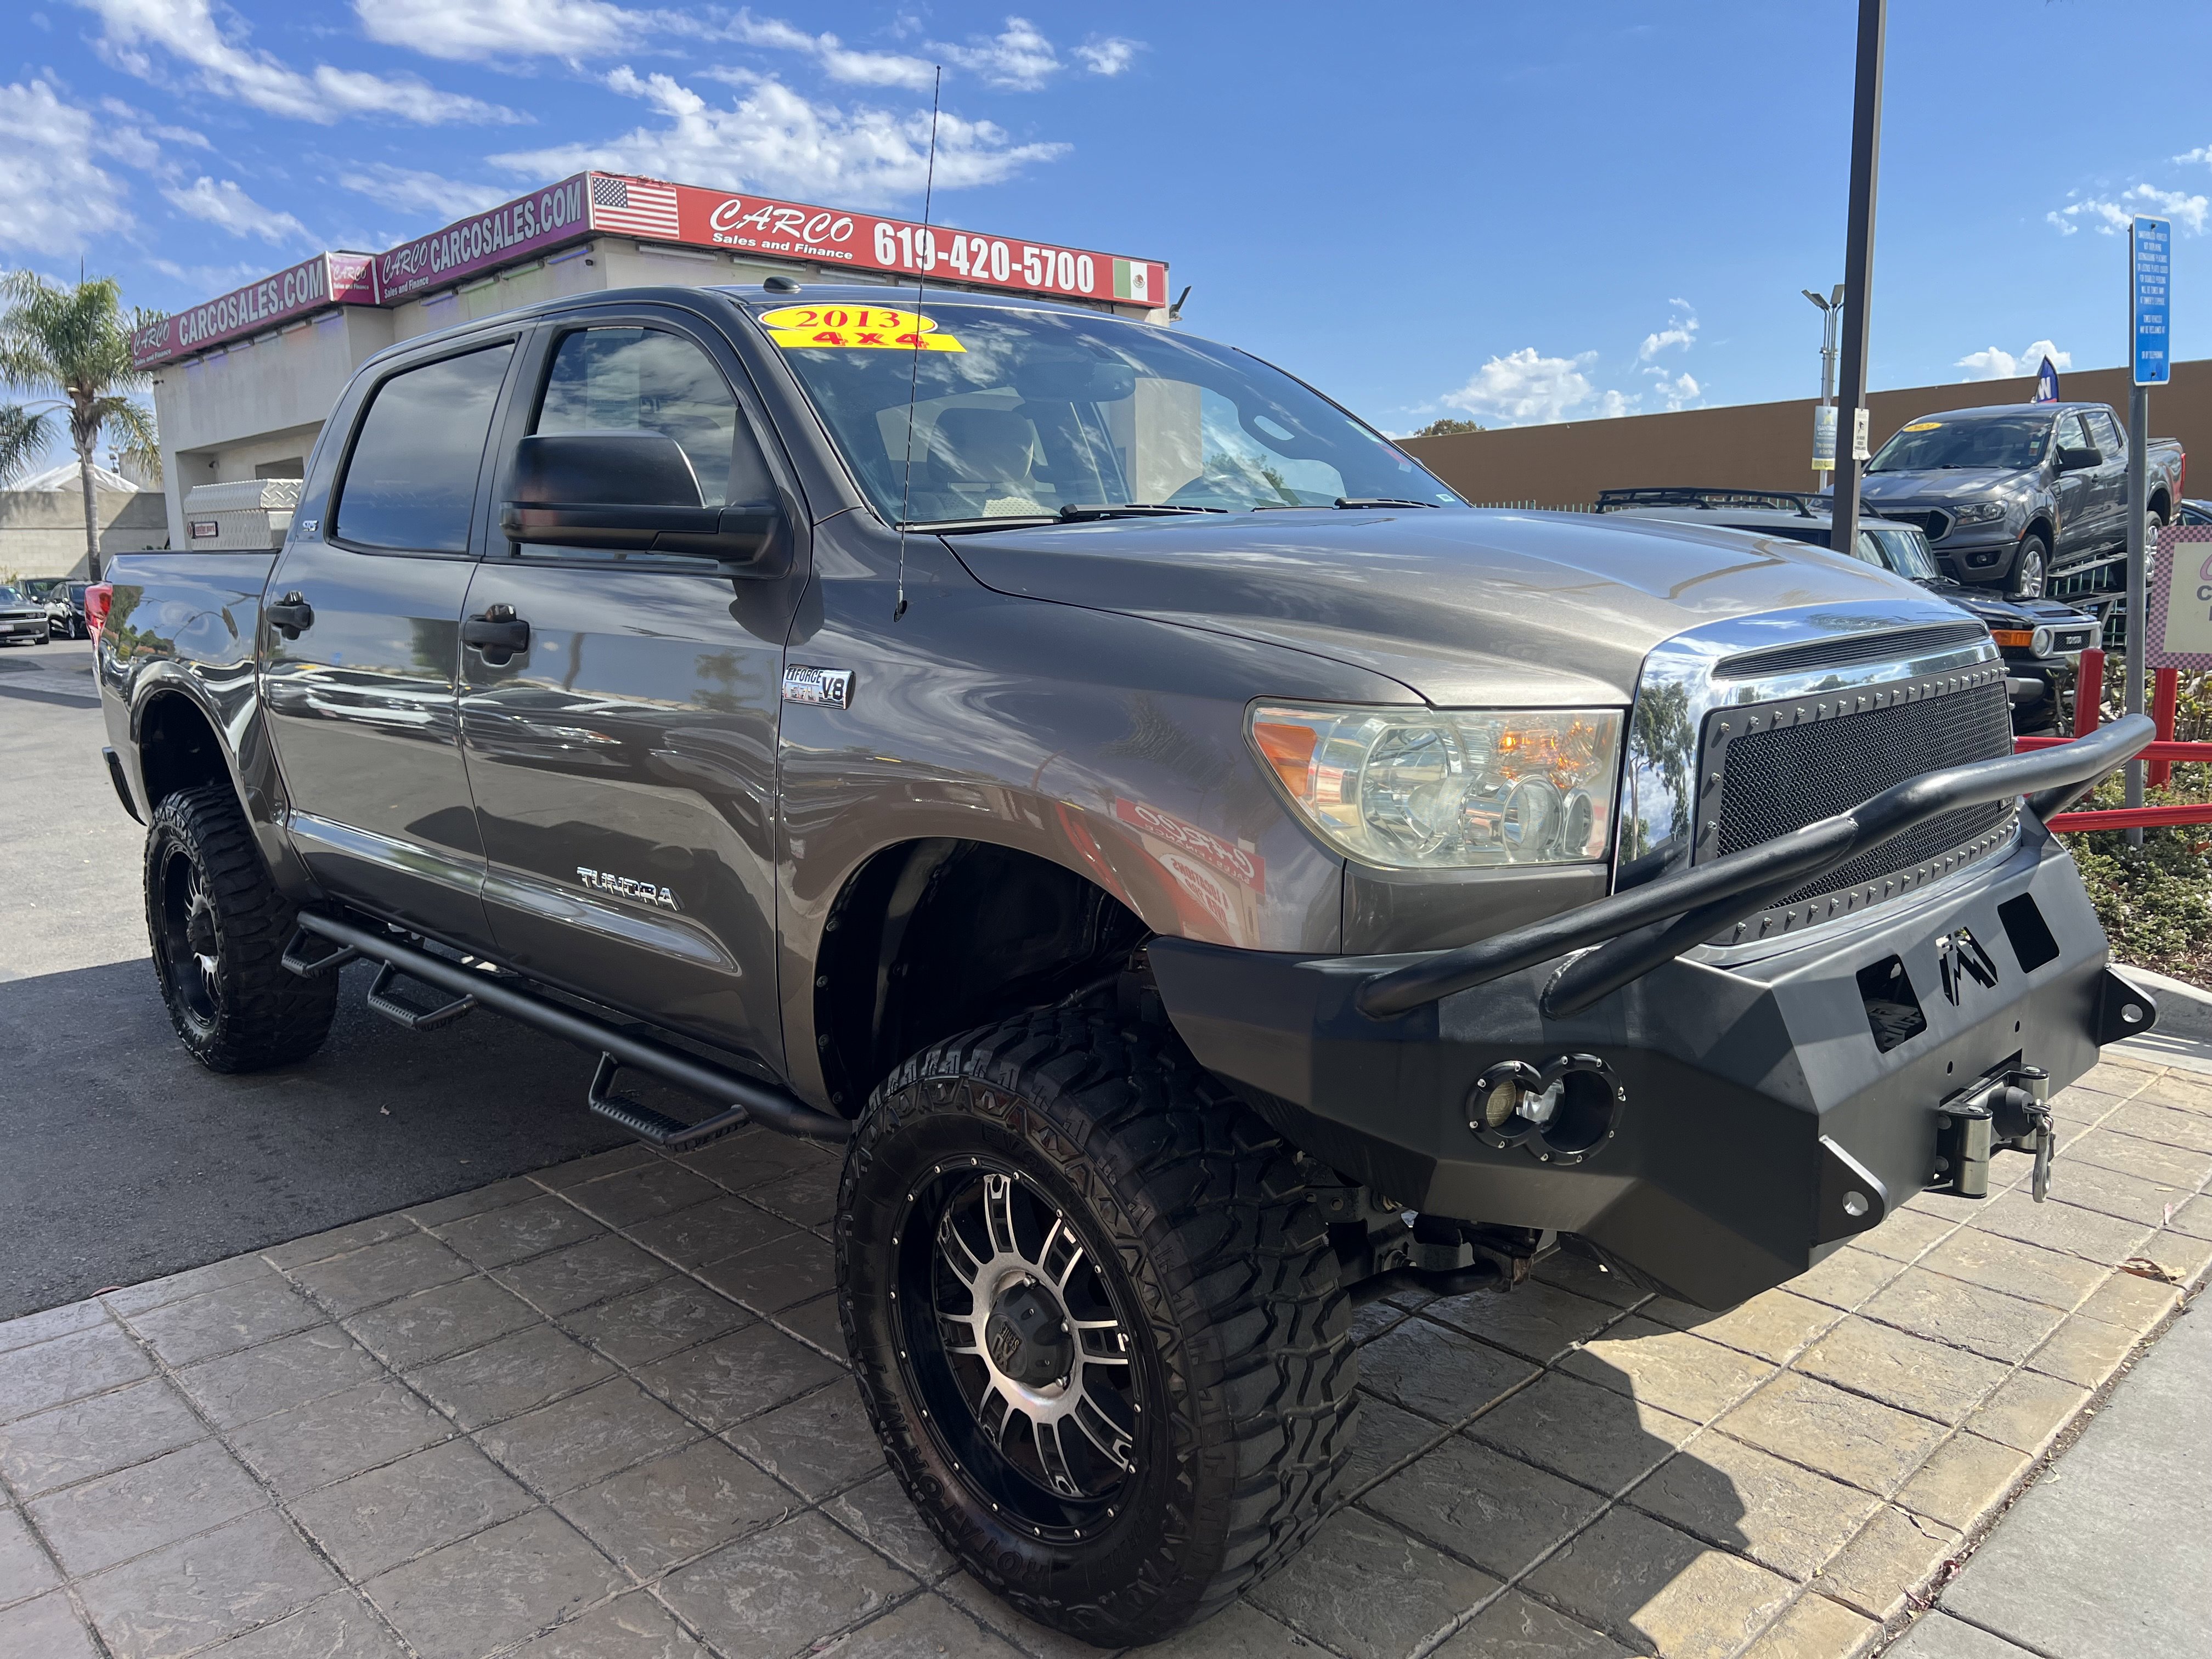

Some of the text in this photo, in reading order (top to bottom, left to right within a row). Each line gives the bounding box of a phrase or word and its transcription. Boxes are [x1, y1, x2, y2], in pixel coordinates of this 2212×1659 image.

[430, 180, 582, 274] CARCOSALES.COM
[709, 199, 854, 244] CARCO
[382, 241, 428, 285] CARCO
[712, 232, 854, 260] Sales and Finance
[873, 222, 1096, 294] 619-420-5700
[333, 265, 367, 281] CARCO
[384, 275, 429, 299] Sales and Finance
[179, 260, 324, 347] CARCOSALES.COM
[794, 310, 901, 329] 2013
[134, 320, 170, 357] CARCO
[822, 676, 845, 701] V8
[576, 866, 679, 911] TUNDRA
[998, 1321, 1020, 1352] SERIES
[901, 1445, 1047, 1591] ROTATOR
